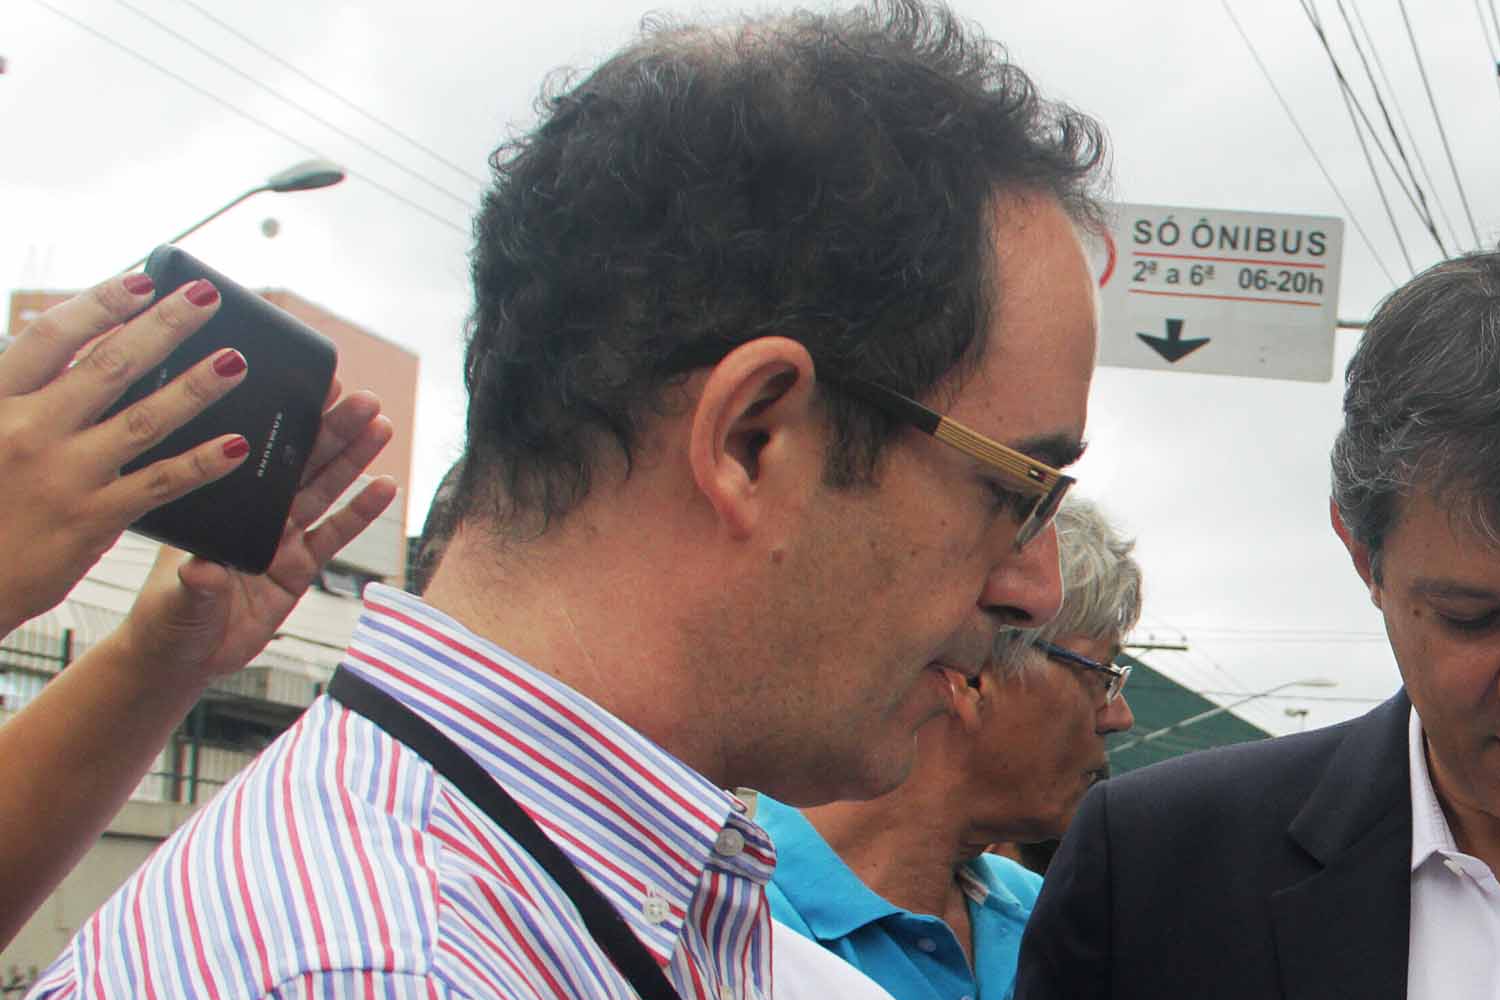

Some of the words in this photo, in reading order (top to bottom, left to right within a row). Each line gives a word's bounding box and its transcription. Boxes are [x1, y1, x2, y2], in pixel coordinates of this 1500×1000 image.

[1133, 215, 1181, 247] SÓ
[1191, 218, 1327, 257] ÔNIBUS
[1132, 260, 1157, 282] 2ª
[1165, 267, 1180, 285] a
[1189, 264, 1215, 286] 6ª
[1238, 267, 1324, 295] 06-20h
